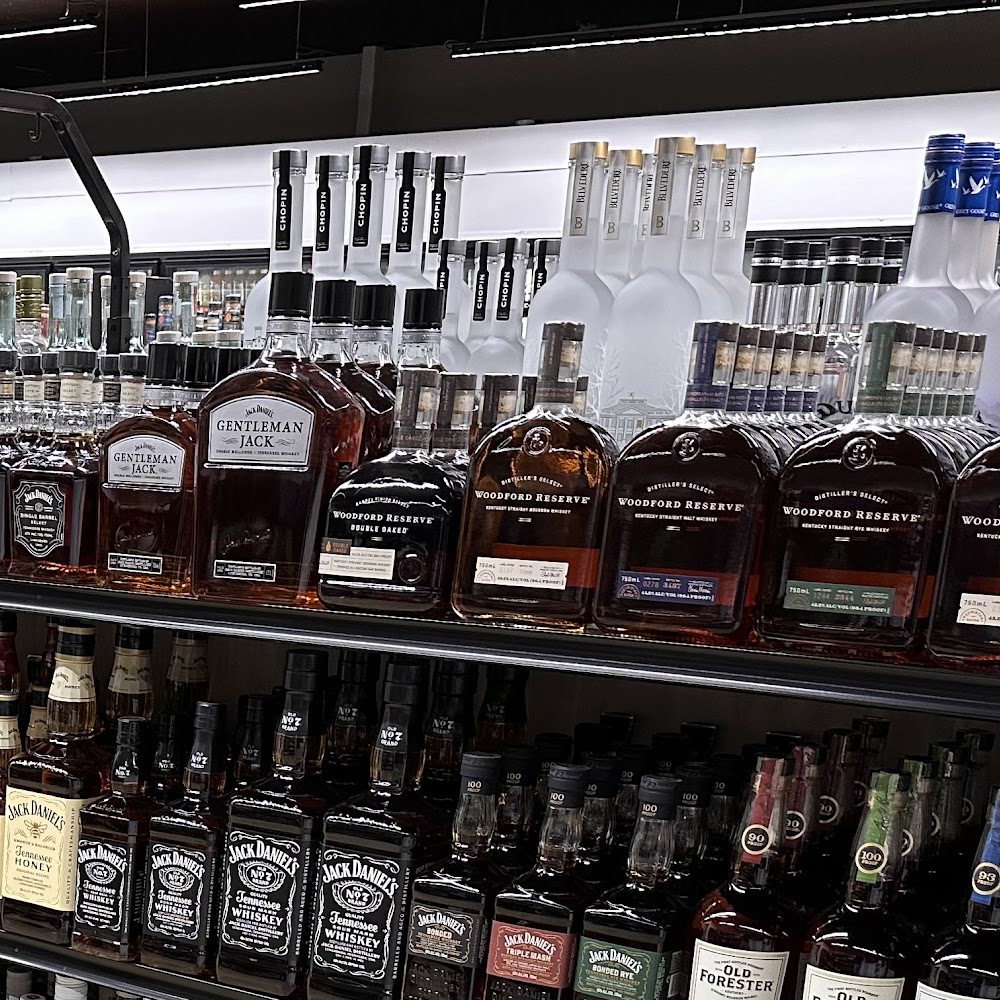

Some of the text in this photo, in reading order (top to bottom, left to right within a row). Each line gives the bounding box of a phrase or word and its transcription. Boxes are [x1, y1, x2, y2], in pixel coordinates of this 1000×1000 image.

[279, 188, 287, 232] CHOPIN
[319, 192, 327, 233] CHOPIN
[357, 183, 367, 227] CHOPIN
[401, 191, 410, 233] CHOPIN
[432, 193, 441, 234] CHOPIN
[477, 274, 485, 309] CHOPIN
[500, 271, 511, 308] CHOPIN
[216, 420, 303, 433] GENTLEMAN
[239, 435, 274, 448] JACK
[113, 453, 177, 464] GENTLEMAN
[131, 464, 156, 474] JACK
[475, 490, 590, 505] WOODFORD RESERVE
[618, 498, 745, 512] WOODFORD RESERVE
[333, 510, 435, 525] WOODFORD RESERVE
[783, 506, 921, 523] WOODFORD RESERVE
[351, 524, 379, 534] DOUBLE
[467, 781, 482, 789] 100
[8, 800, 66, 831] JACK DANIEL'S
[642, 804, 657, 813] 100
[748, 833, 765, 843] 90
[229, 839, 300, 877] JACK DANIEL'S
[860, 851, 882, 862] 100
[15, 858, 53, 872] HONEY
[151, 851, 206, 879] JACK DANIEL'S
[322, 859, 399, 898] JACK DANIEL'S
[978, 871, 996, 882] 93
[231, 907, 284, 927] WHISKEY
[324, 928, 381, 949] WHISKEY
[504, 931, 557, 957] JACK DANIEL'S
[506, 947, 551, 962] TRIPLE MASH
[589, 948, 643, 974] JACK DANIEL'S
[592, 965, 635, 981] BONDED RYE
[723, 965, 751, 978] OLD
[700, 969, 774, 992] FORESTER
